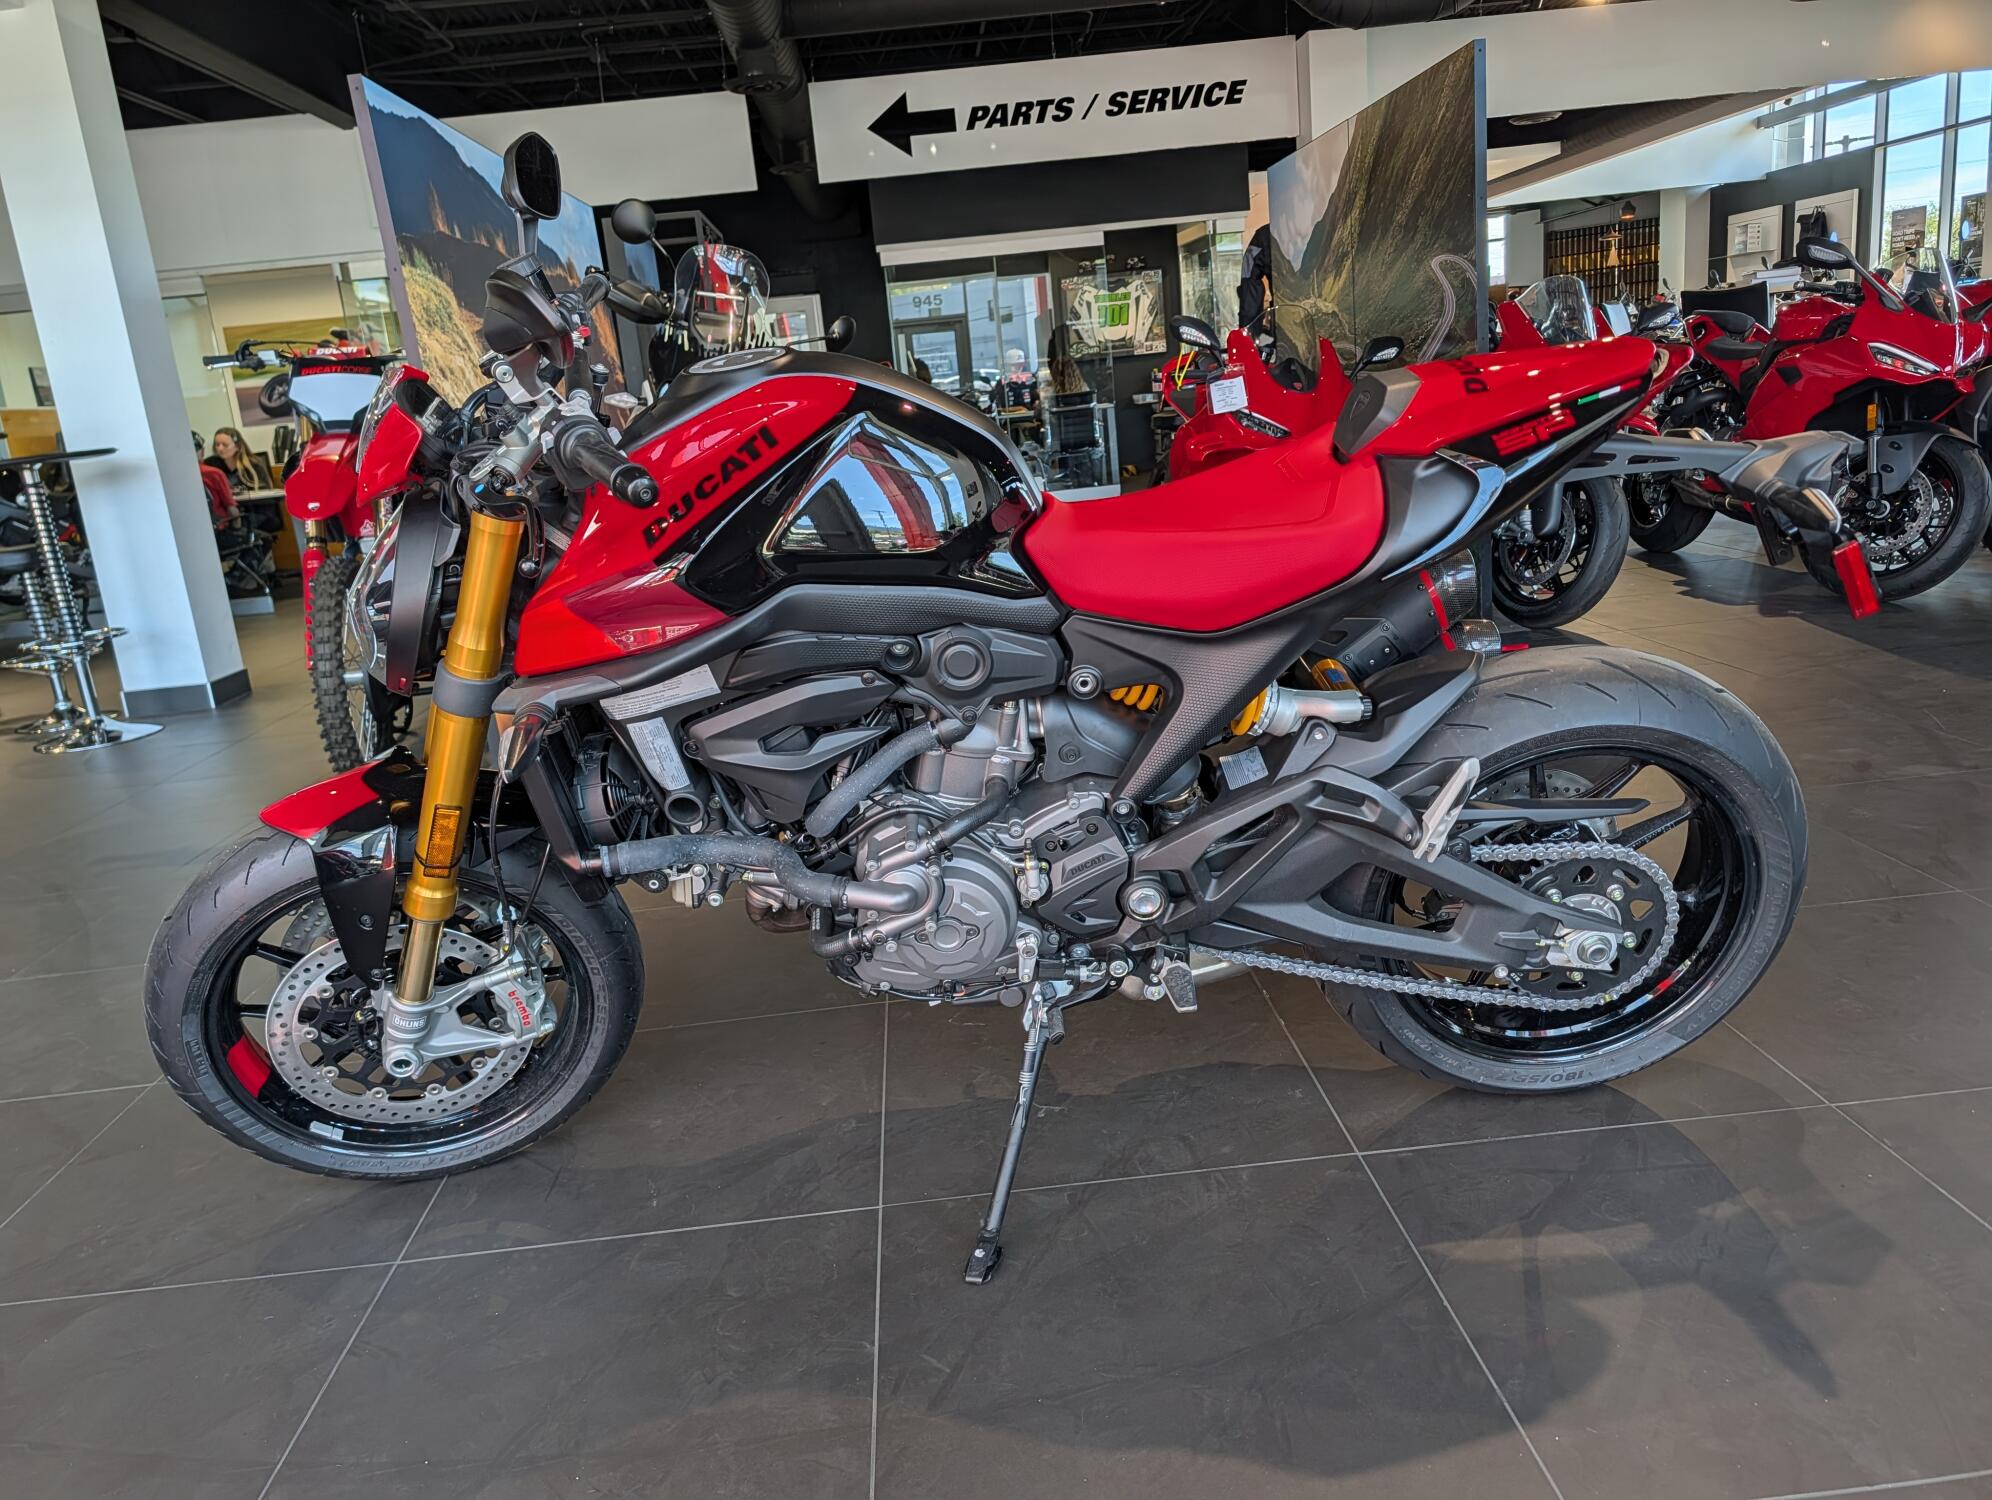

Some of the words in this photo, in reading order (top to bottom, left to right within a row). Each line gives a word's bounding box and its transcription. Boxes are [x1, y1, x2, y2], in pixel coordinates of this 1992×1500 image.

[966, 96, 1075, 131] PARTS
[1080, 93, 1100, 120] /
[1105, 79, 1248, 118] SERVICE
[912, 294, 944, 308] 945
[642, 425, 779, 549] DUCATI
[1069, 853, 1106, 876] DUCATI
[507, 989, 532, 1027] brembo
